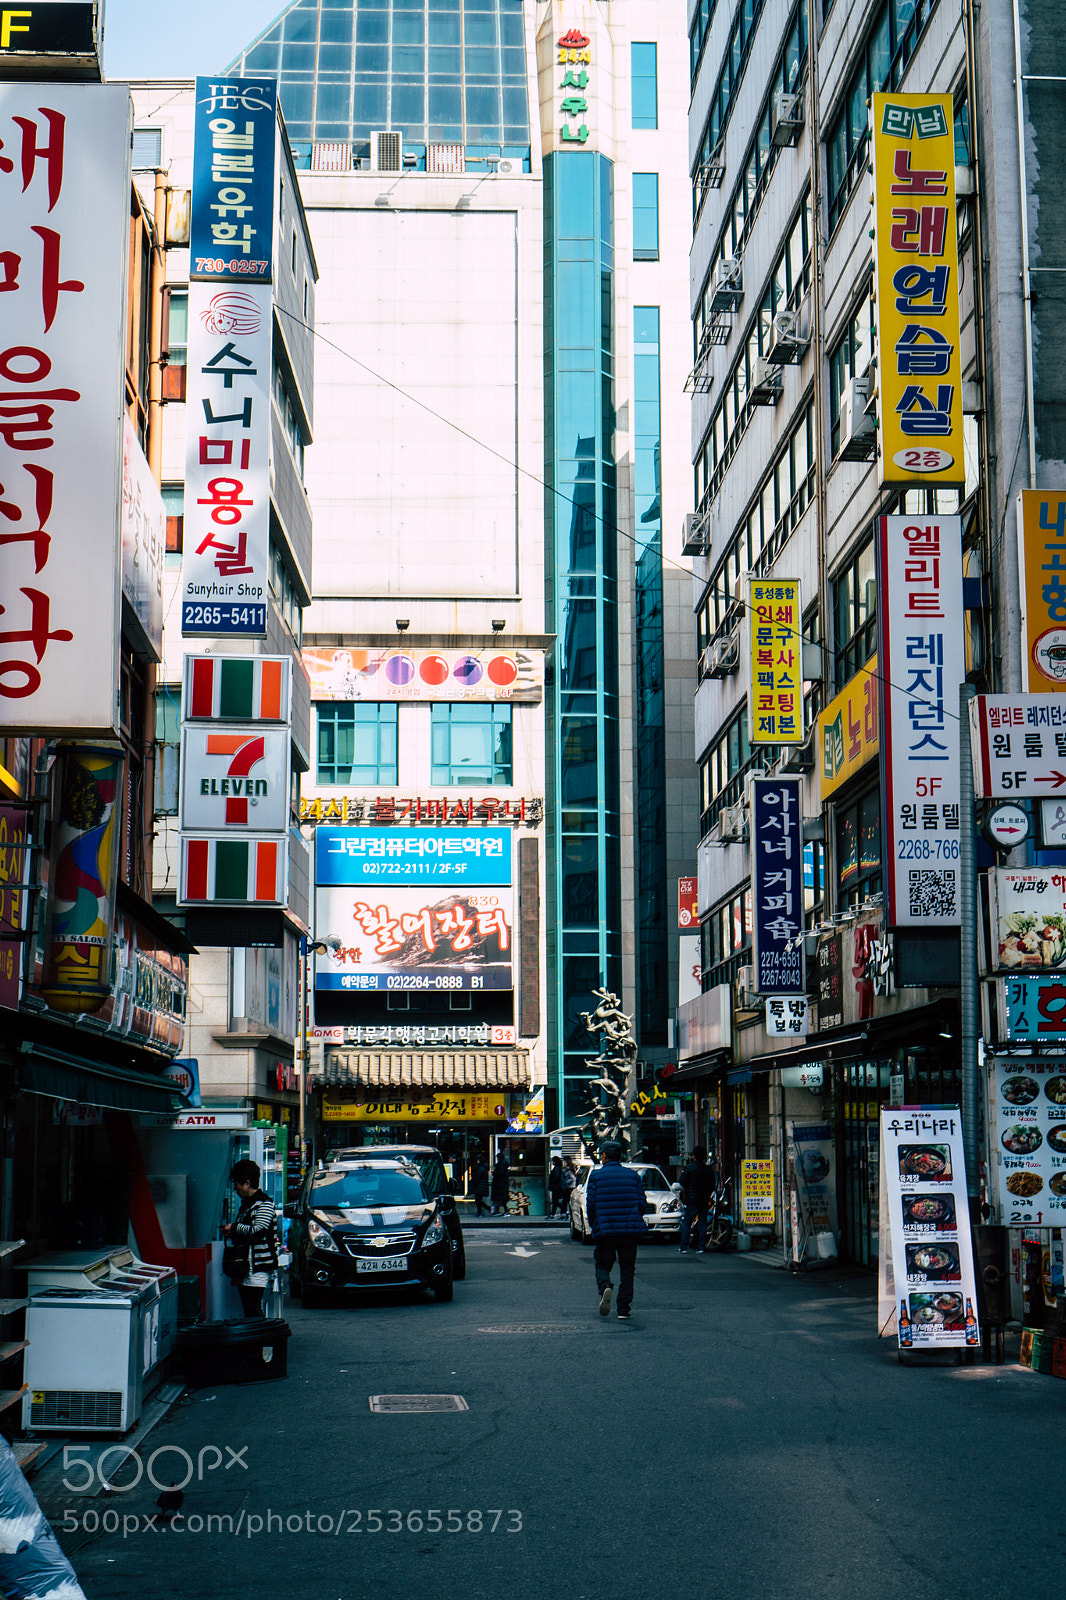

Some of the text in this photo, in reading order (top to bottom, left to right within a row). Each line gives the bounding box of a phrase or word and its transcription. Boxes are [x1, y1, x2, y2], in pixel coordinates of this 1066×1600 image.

[558, 48, 592, 64] 24시
[204, 84, 266, 115] JEC
[560, 70, 590, 144] 사우나
[886, 108, 941, 133] 만남
[208, 117, 257, 255] 일본유학
[195, 257, 269, 275] 730-0257
[890, 148, 955, 436] 노래연습실
[903, 449, 942, 469] 2층
[902, 525, 946, 619] 엘리트
[186, 582, 264, 600] Sunyhair Shop
[753, 587, 795, 600] 동성종합
[184, 603, 265, 626] 2265-5411
[756, 605, 793, 625] 인쇄
[755, 627, 794, 647] 문구
[756, 649, 795, 669] 복사
[757, 671, 795, 690] 팩스
[757, 693, 795, 713] 코팅
[905, 633, 950, 761] 레지던스
[758, 715, 796, 735] 제본
[988, 706, 1026, 728] 엘리트
[206, 735, 265, 824] 7
[915, 776, 943, 797] 5F
[1001, 770, 1028, 789] 5F
[300, 796, 349, 821] 24시
[373, 796, 526, 822] 불가마사우나
[900, 803, 960, 831] 원룸텔
[760, 788, 797, 861] 아사녀
[327, 837, 503, 858] 그린컴퓨터아트학원
[898, 839, 960, 860] 2268-766
[362, 862, 431, 875] 02)722-2111
[1013, 878, 1049, 894] 내고향
[468, 895, 500, 907] 830
[762, 867, 800, 941] 커피숍
[352, 902, 510, 955] 활어장터
[341, 975, 484, 989] 예약문의 02)2264-0888 B1
[1011, 983, 1030, 1033] 카스
[347, 1025, 488, 1045] 박문각행정고시학원
[186, 1116, 216, 1125] ATM
[887, 1118, 957, 1136] 우리나라
[380, 1260, 404, 1269] 6344
